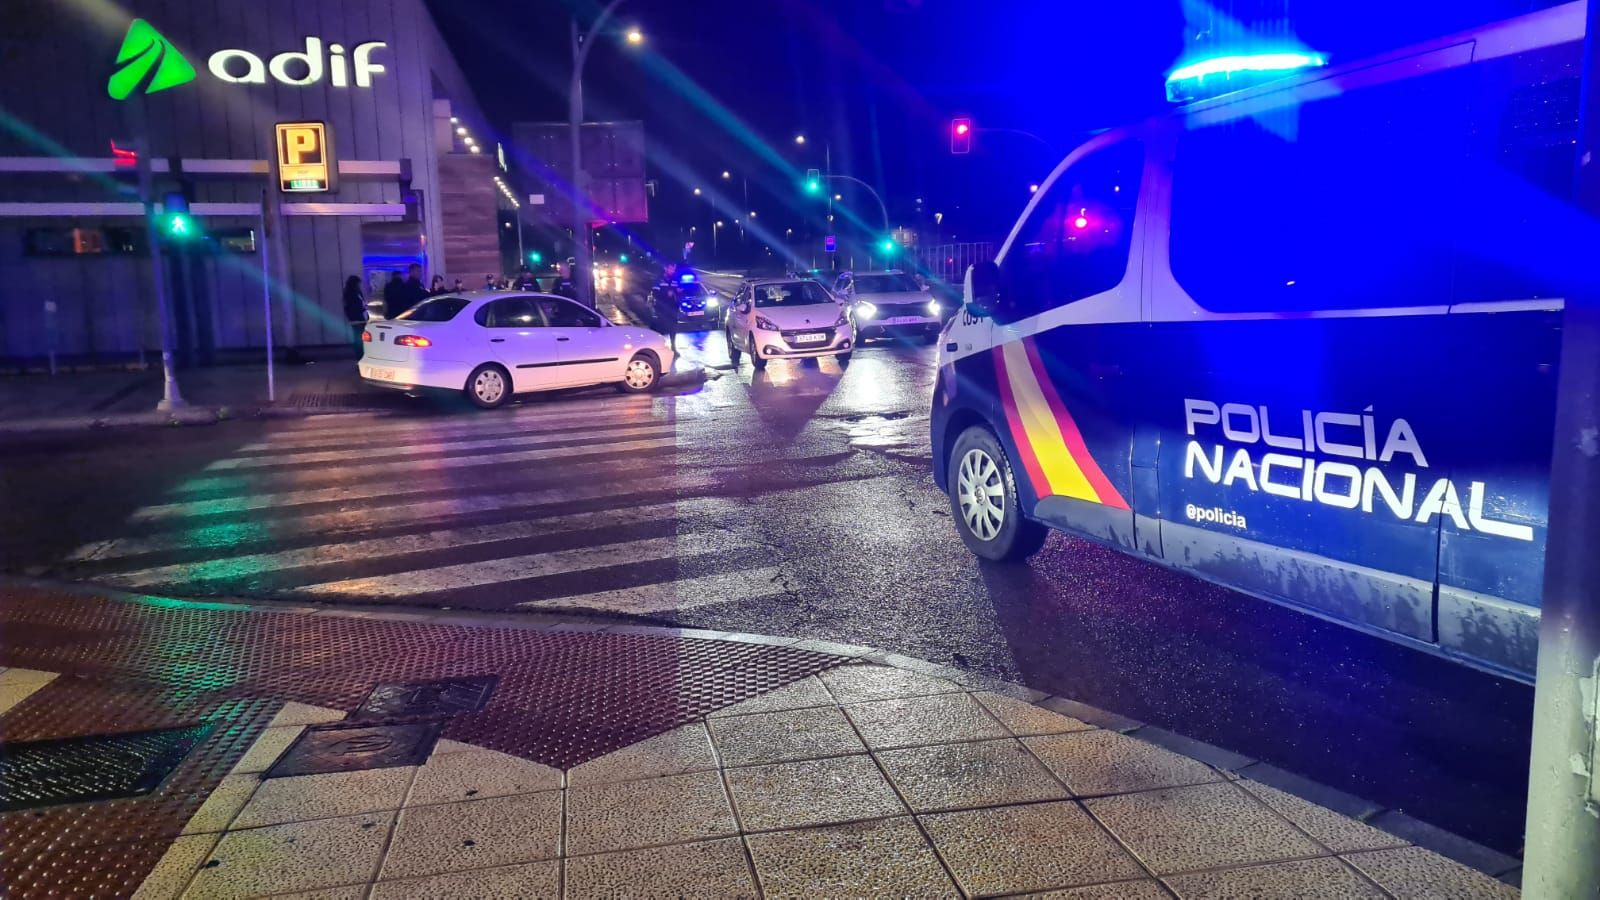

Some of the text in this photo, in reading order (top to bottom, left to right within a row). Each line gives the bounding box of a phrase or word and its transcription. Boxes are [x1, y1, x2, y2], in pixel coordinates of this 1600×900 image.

[208, 36, 387, 87] adif
[286, 128, 316, 164] P
[1184, 398, 1429, 468] POLICÍA
[1184, 440, 1534, 541] NACIONAL
[1186, 504, 1247, 529] @policia
